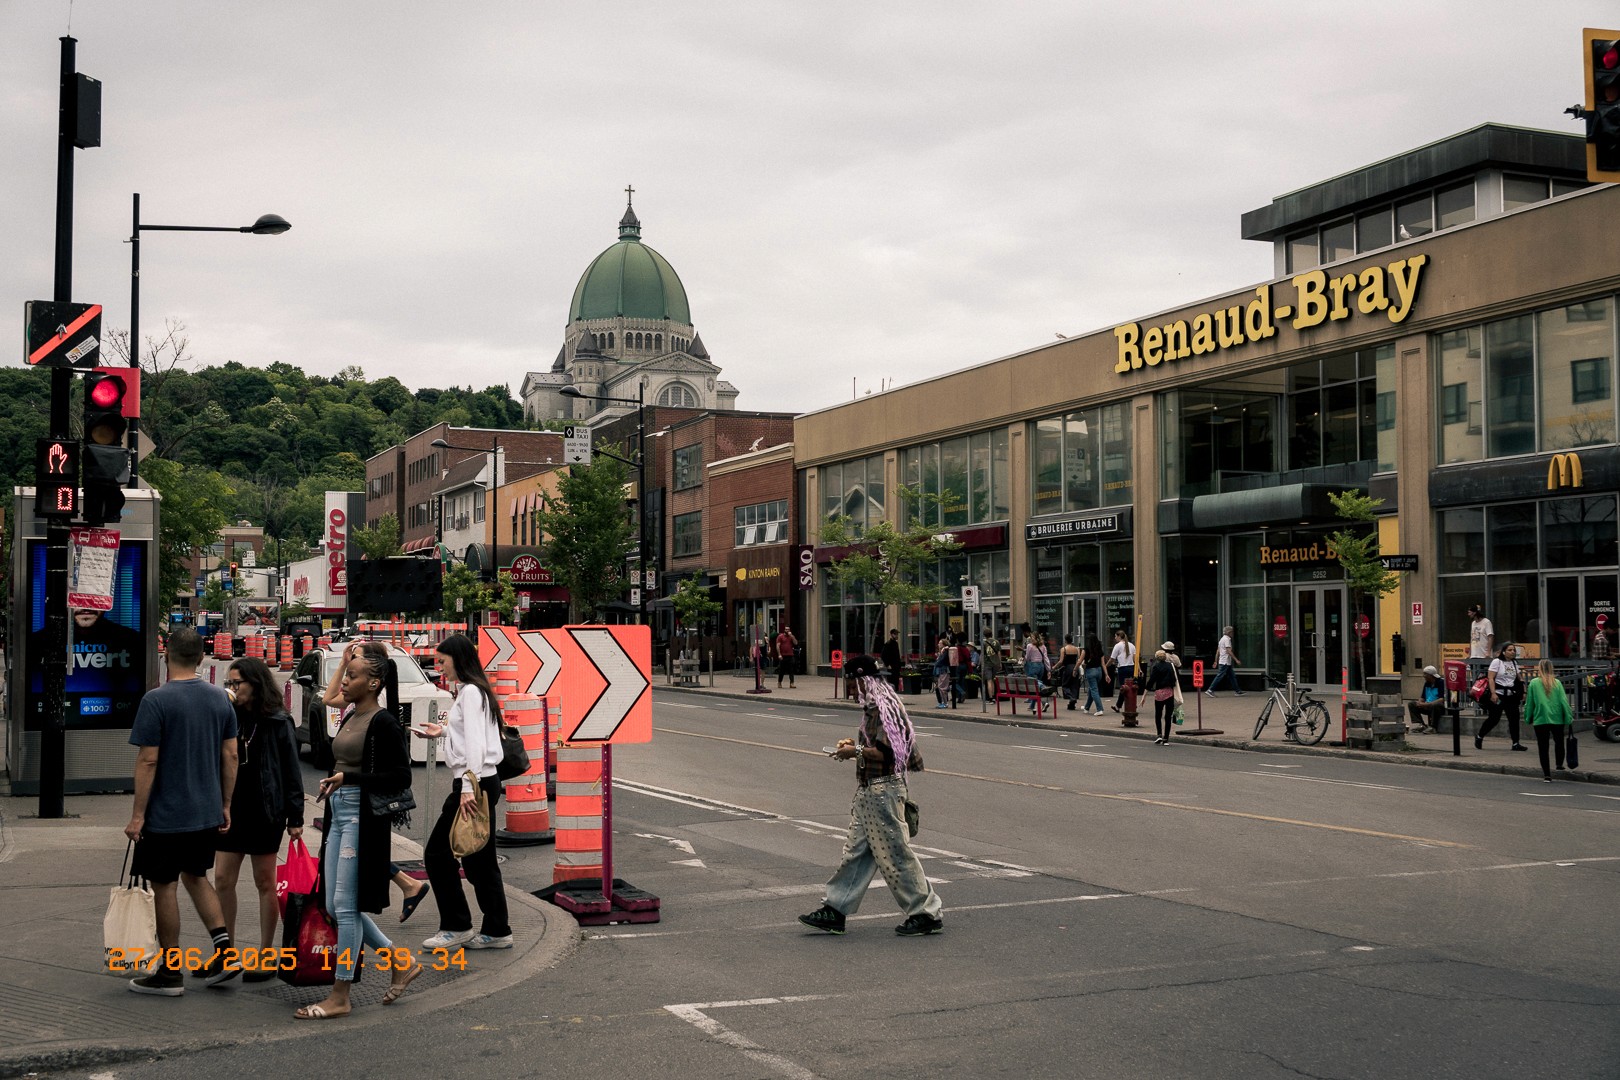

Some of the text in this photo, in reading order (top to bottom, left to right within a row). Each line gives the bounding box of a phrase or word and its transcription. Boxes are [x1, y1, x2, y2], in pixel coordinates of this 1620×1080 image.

[1114, 254, 1427, 374] Renaud-Bray
[57, 487, 73, 511] 0
[1037, 522, 1073, 535] BRULERIE
[1075, 517, 1112, 530] URBAINE
[326, 509, 346, 591] etro
[521, 572, 549, 580] FRUITS
[1312, 571, 1327, 579] 5252
